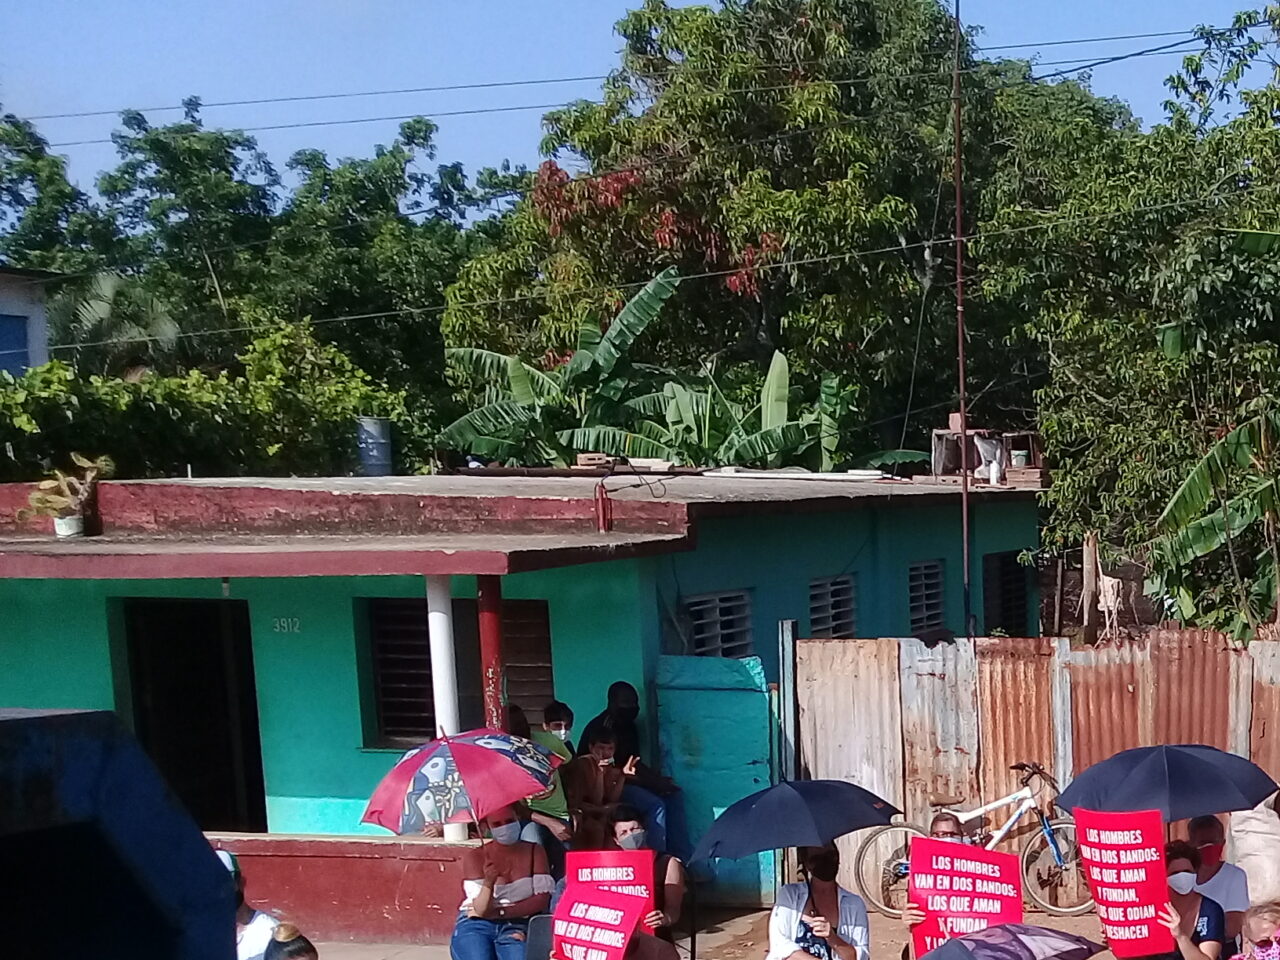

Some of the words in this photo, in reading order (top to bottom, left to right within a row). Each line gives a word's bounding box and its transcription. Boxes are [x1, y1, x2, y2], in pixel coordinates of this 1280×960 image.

[273, 617, 300, 632] 3912
[1086, 828, 1099, 843] LOS
[1099, 830, 1143, 845] HOMBRES
[1101, 850, 1118, 864] DOS
[1119, 848, 1160, 864] BANDOS:
[578, 868, 591, 882] LOS
[592, 867, 634, 881] HOMBRES
[932, 856, 951, 870] LOS
[953, 857, 1000, 877] HOMBRES
[1101, 869, 1119, 883] QUE
[1120, 868, 1147, 883] AMAN
[914, 873, 934, 889] VAN
[936, 875, 950, 890] EN
[952, 878, 973, 892] DOS
[975, 879, 1018, 897] BANDOS:
[1102, 887, 1139, 903] FUNDAN,
[569, 902, 588, 918] LOS
[927, 895, 947, 911] LOS
[949, 896, 970, 912] QUE
[972, 897, 1001, 914] AMAN
[1107, 907, 1125, 921] QUE
[1126, 904, 1156, 920] ODIAN
[576, 925, 595, 942] DOS
